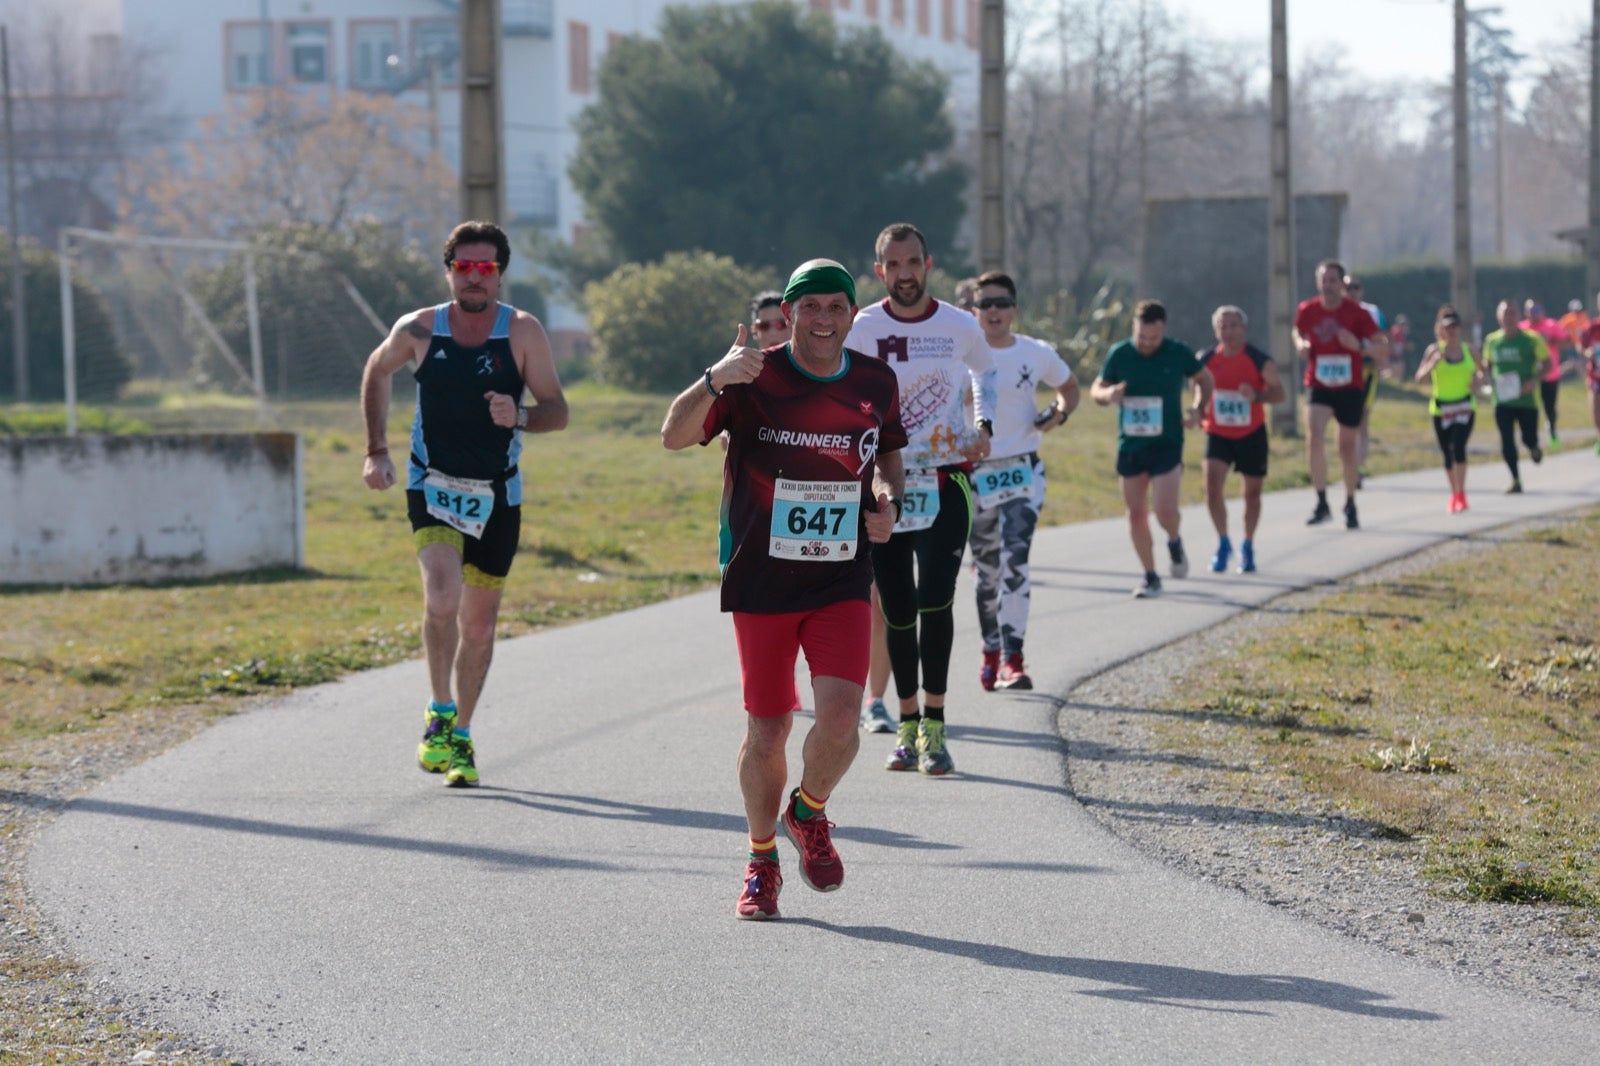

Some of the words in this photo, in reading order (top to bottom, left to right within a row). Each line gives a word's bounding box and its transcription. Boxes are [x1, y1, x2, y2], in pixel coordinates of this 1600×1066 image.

[910, 337, 922, 345] 35
[923, 337, 954, 345] MEDIA
[1131, 408, 1151, 424] 55
[758, 426, 852, 449] GINRUNNERS
[818, 448, 849, 456] GRANADA
[797, 483, 812, 492] GRAN
[813, 484, 833, 492] PREMIO
[833, 484, 840, 492] DE
[841, 484, 857, 492] FONDO
[986, 468, 1024, 491] 926
[436, 490, 481, 518] 812
[787, 506, 847, 536] 647
